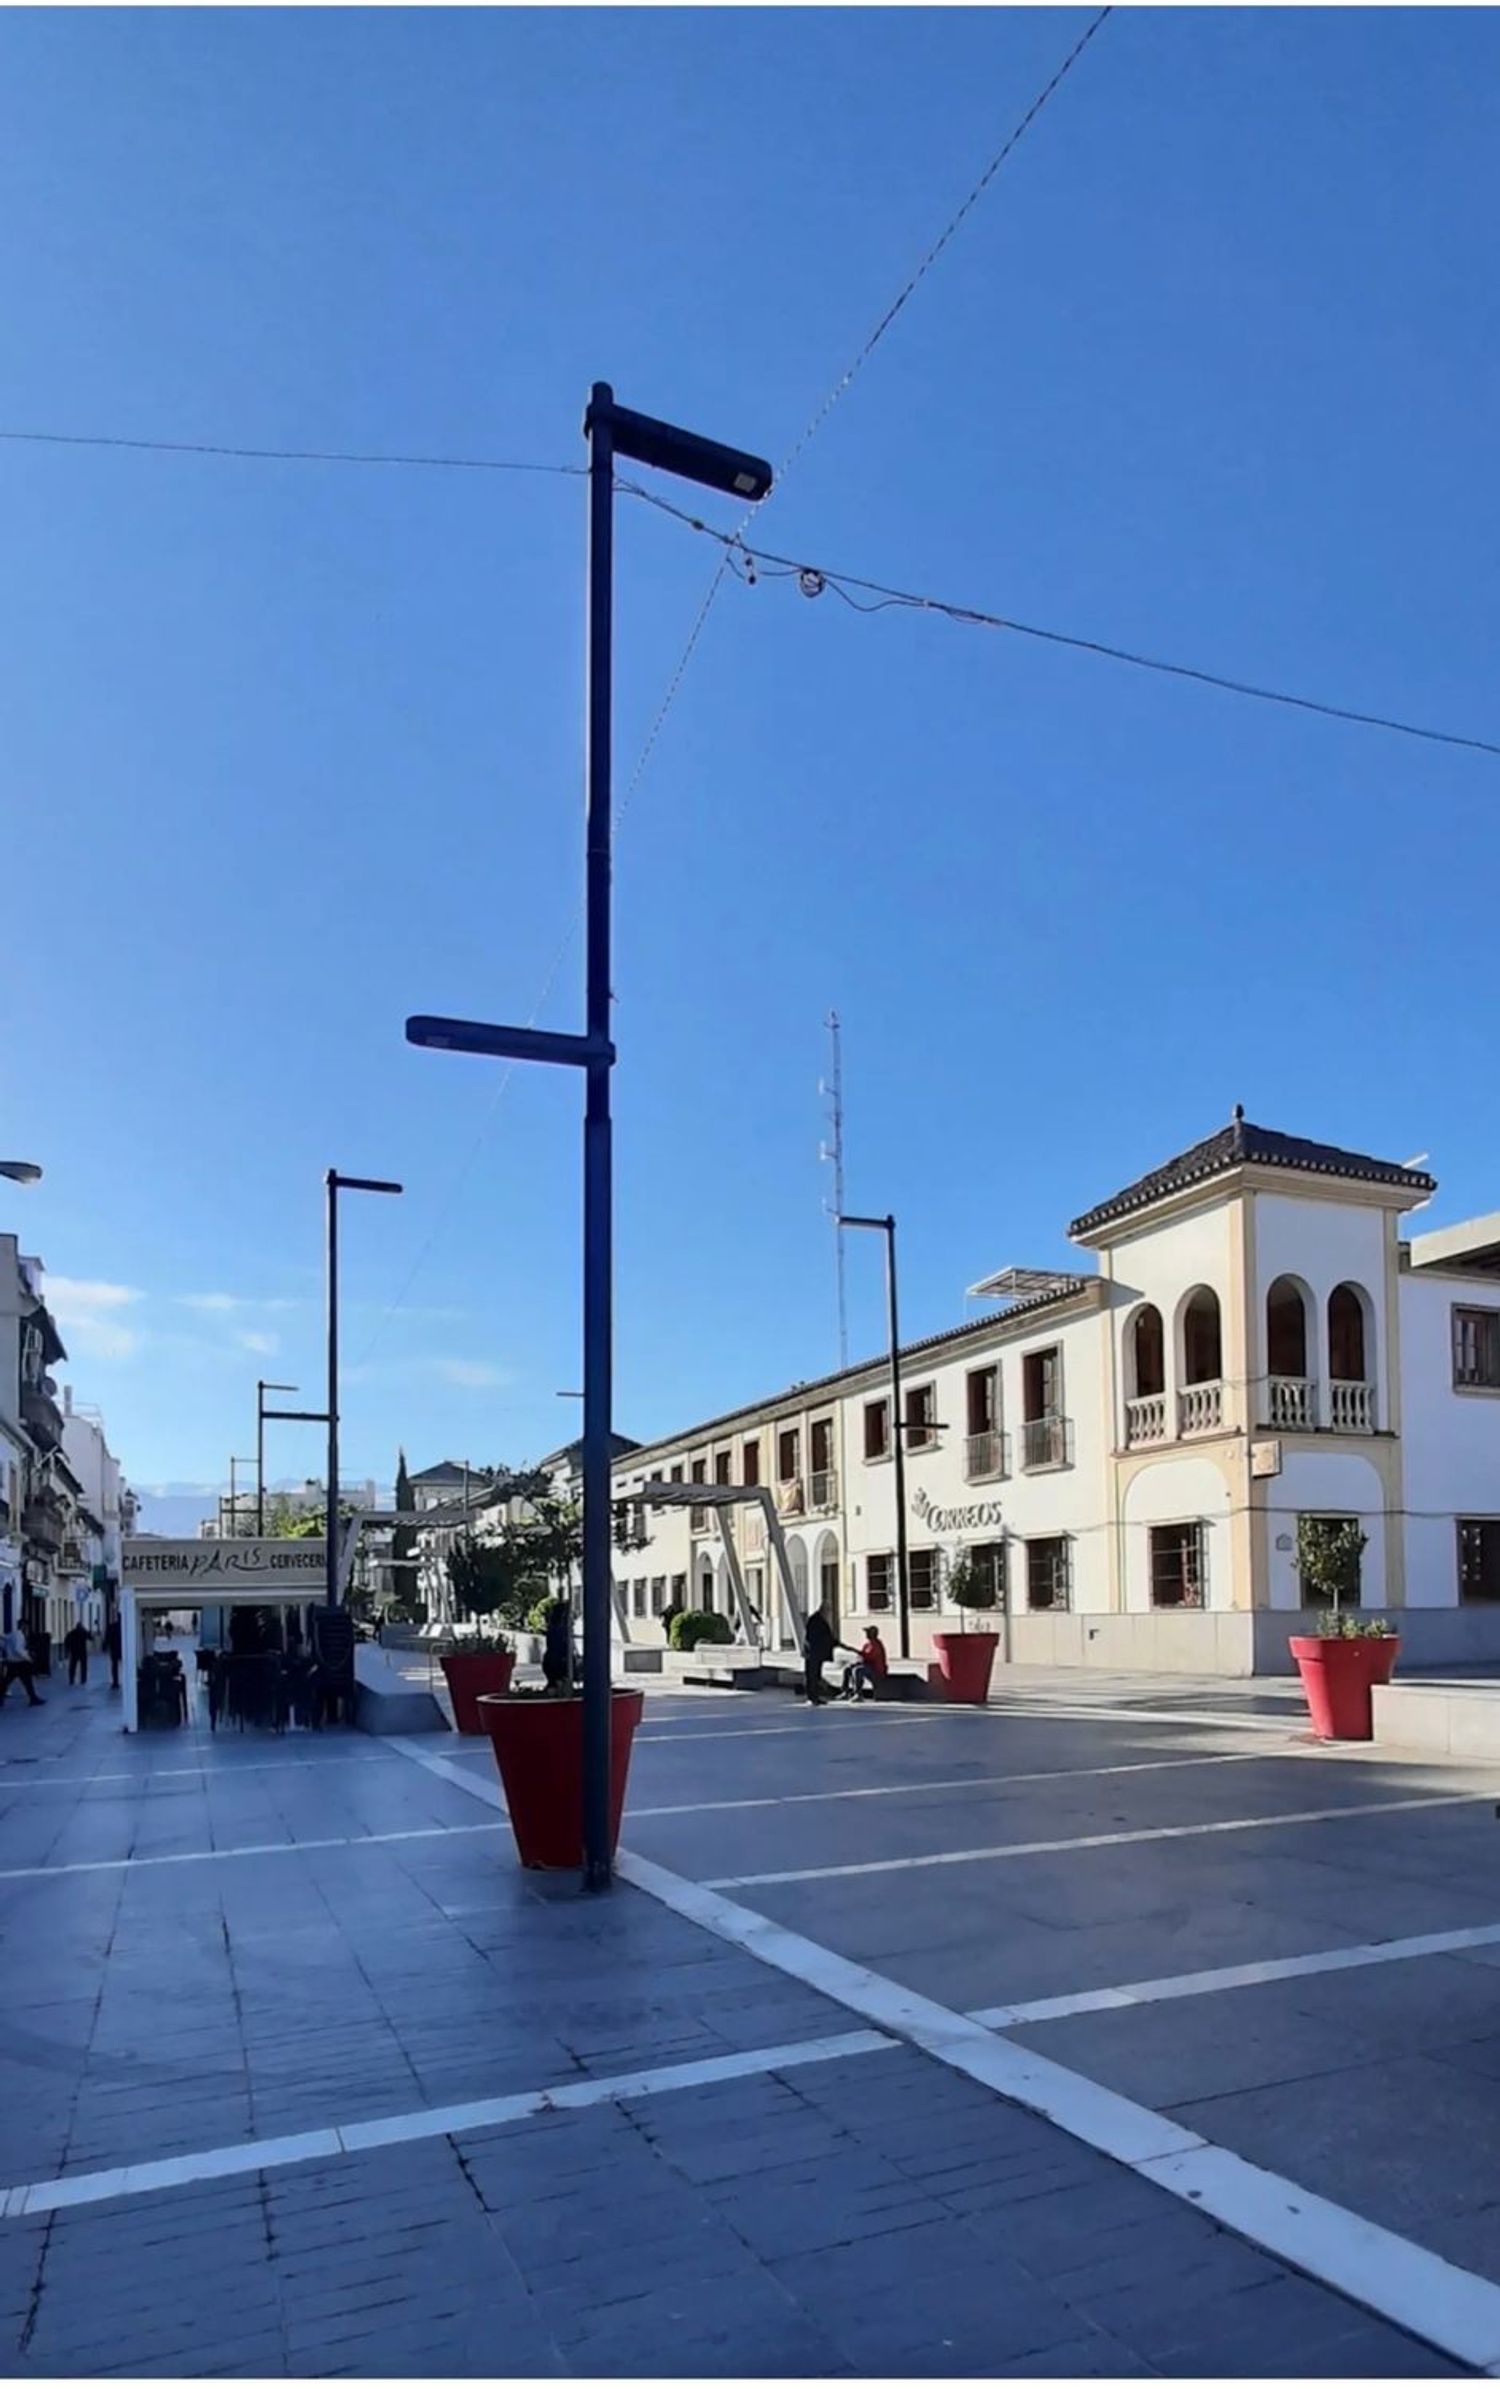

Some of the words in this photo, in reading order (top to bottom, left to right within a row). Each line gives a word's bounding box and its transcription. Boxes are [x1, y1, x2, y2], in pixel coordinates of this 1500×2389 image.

[927, 1501, 1002, 1532] CORREOS
[190, 1548, 269, 1576] PARIS
[270, 1553, 327, 1569] CERVECERI
